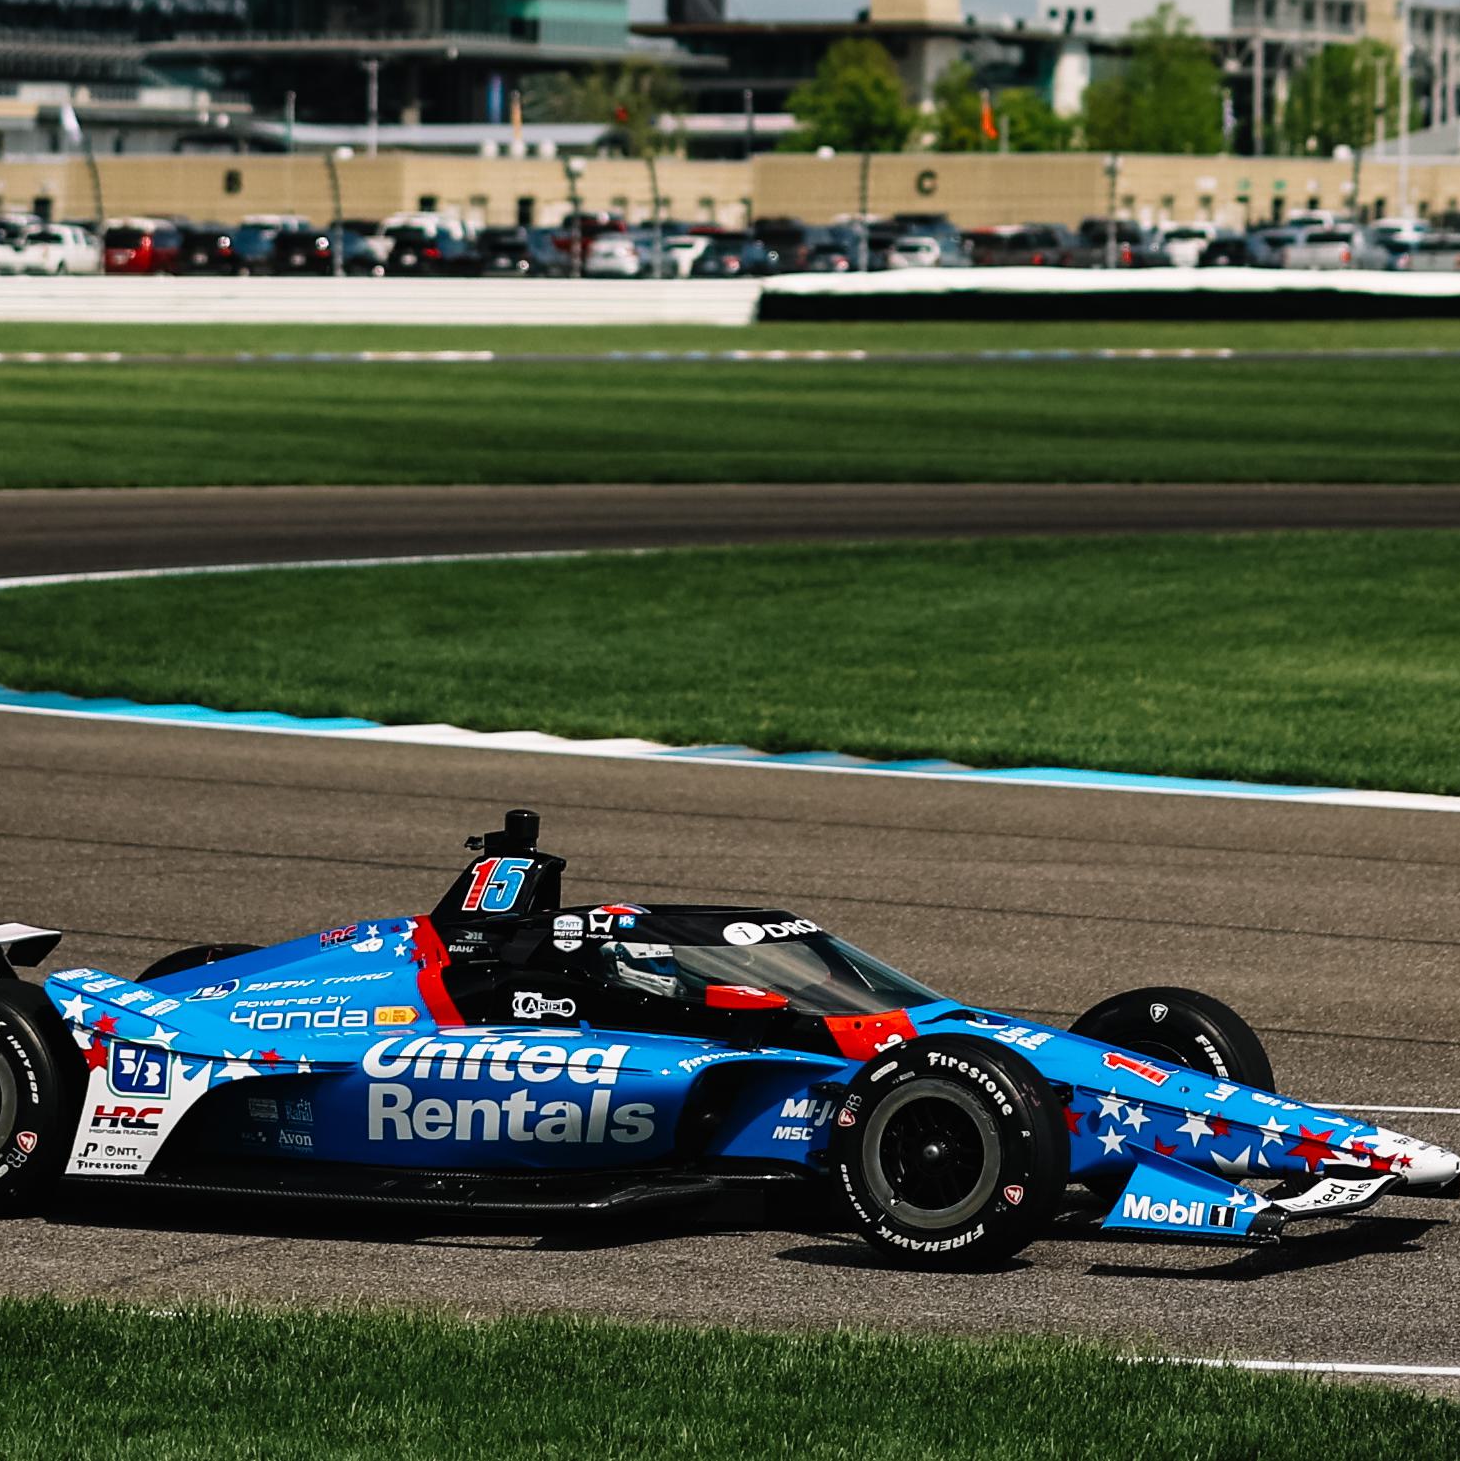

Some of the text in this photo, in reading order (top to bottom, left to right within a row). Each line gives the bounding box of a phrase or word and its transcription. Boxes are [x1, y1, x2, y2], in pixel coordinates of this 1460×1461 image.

[915, 170, 937, 197] C
[461, 857, 534, 911] 15
[320, 924, 358, 949] HRC
[761, 919, 822, 938] DRO
[243, 971, 394, 993] FIFTH THIRD
[235, 994, 351, 1009] Powered by
[525, 999, 570, 1013] ARIEL
[362, 1036, 632, 1085] United
[1194, 1033, 1230, 1078] FIRE
[6, 1034, 40, 1105] INDY 500
[927, 1051, 1014, 1117] Firestone
[90, 1105, 164, 1129] HRC
[367, 1083, 656, 1144] Rentals
[89, 1127, 158, 1137] Honda RACING
[279, 1129, 313, 1146] Avon
[772, 1125, 815, 1141] MSC
[117, 1147, 138, 1156] NTT
[76, 1159, 139, 1170] Firestone
[848, 1193, 872, 1223] INDY
[1122, 1193, 1205, 1227] Mobil
[876, 1223, 985, 1252] FIREHAWK
